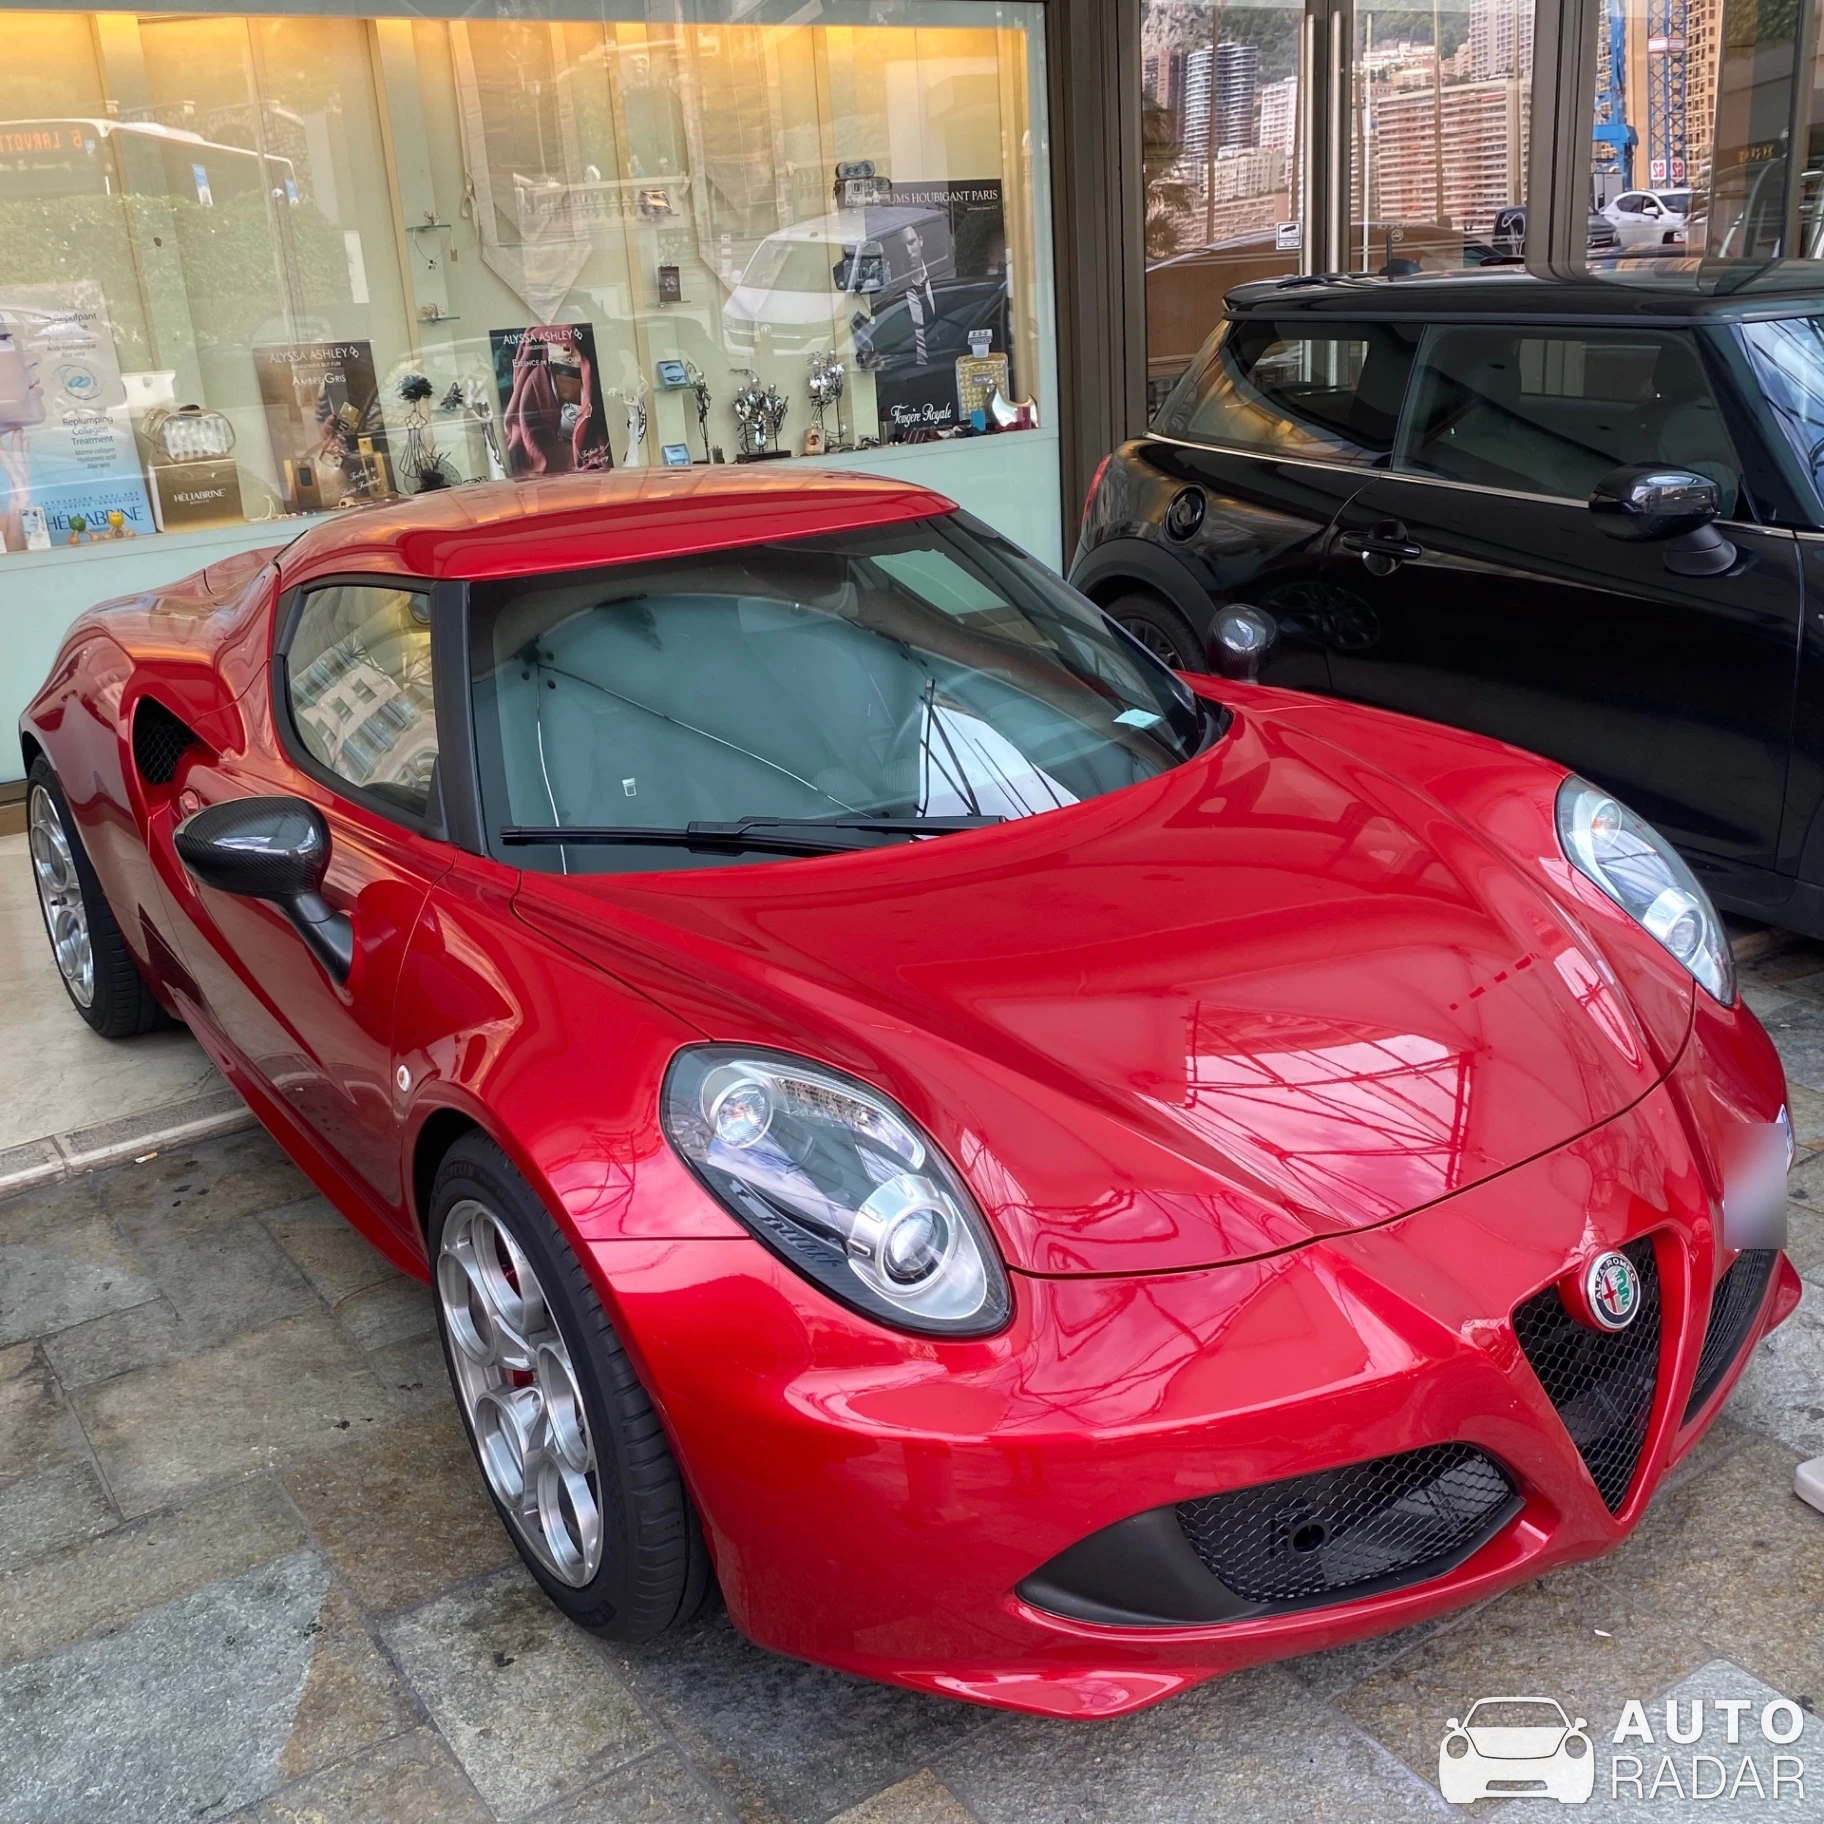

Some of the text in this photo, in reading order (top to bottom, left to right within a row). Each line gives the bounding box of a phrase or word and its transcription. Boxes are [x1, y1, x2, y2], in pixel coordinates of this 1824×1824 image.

[911, 190, 970, 203] HOUBIGANT
[972, 189, 998, 201] PARIS
[503, 330, 573, 345] ALYSSA ASHLEY
[269, 348, 348, 363] ALYSSA ASHLEY
[62, 415, 114, 427] Replumping
[890, 402, 952, 428] Fougère Royale
[72, 426, 109, 435] Collagen
[71, 435, 114, 446] Treatment
[1595, 1258, 1636, 1300] ALFA ROMEO
